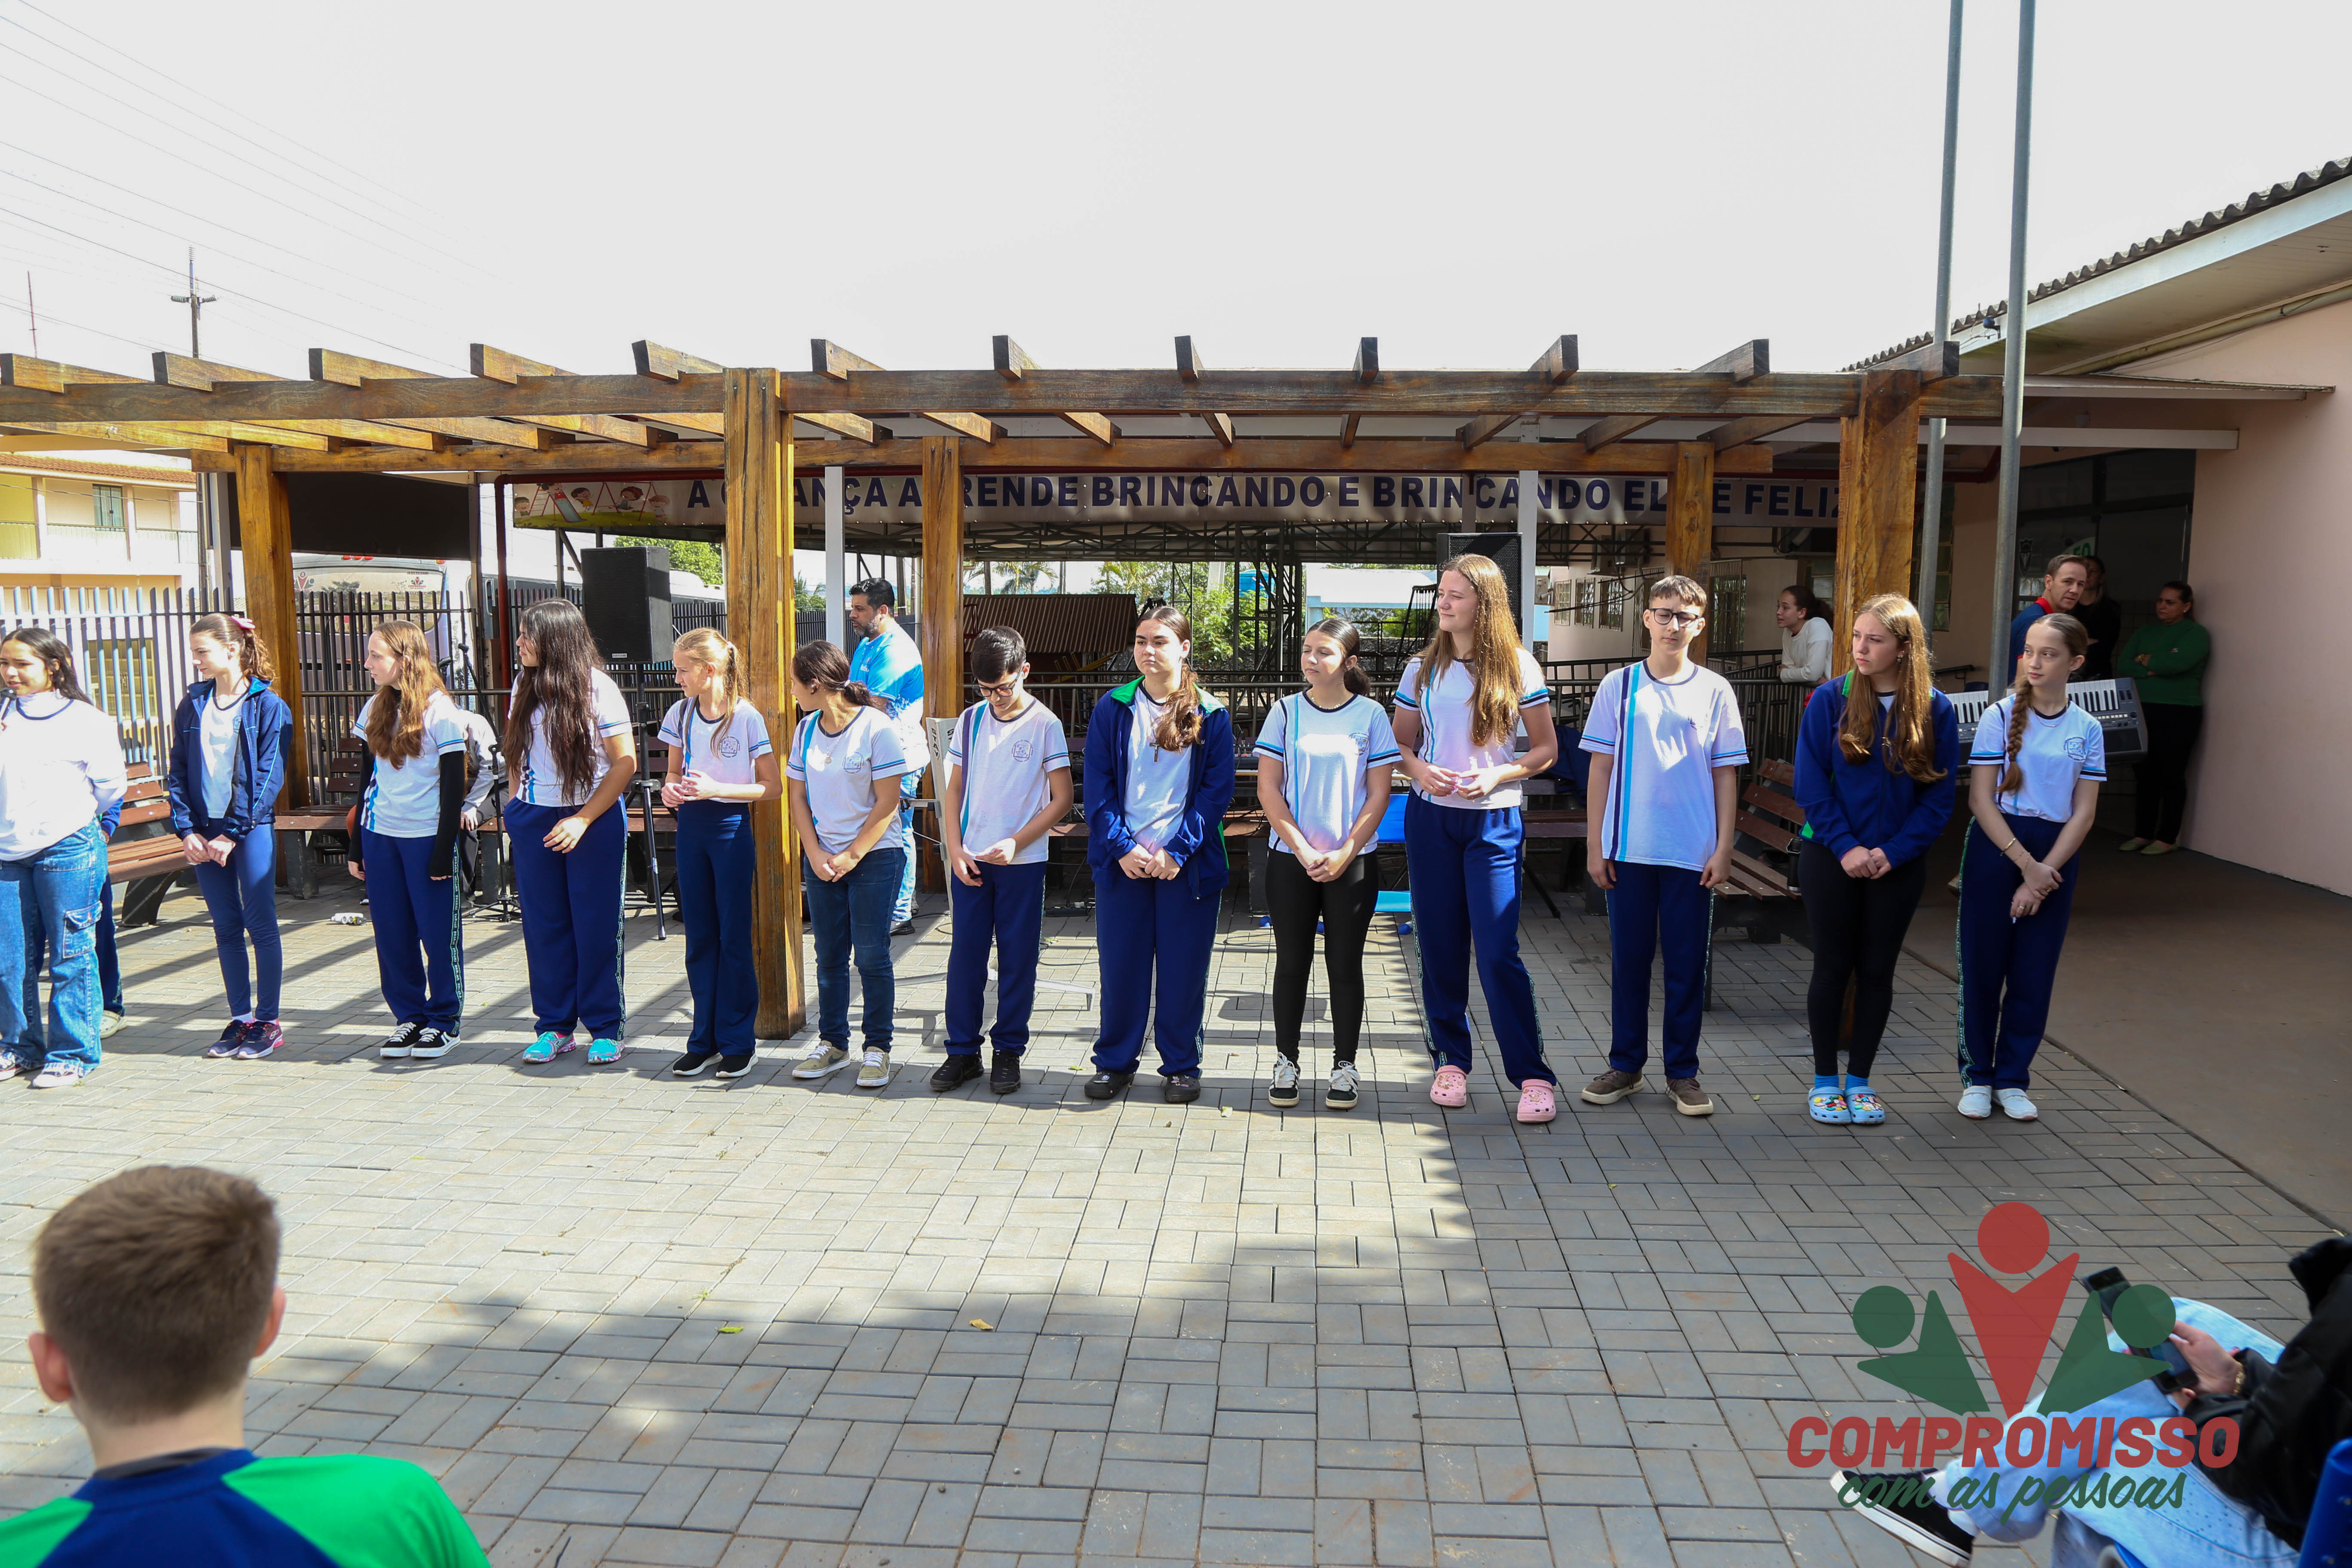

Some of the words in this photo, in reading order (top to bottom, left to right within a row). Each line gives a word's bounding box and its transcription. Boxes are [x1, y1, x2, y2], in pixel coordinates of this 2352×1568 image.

[687, 480, 710, 508] A
[721, 477, 888, 515] ANÇA
[898, 477, 1078, 507] AENDE
[1092, 476, 1325, 507] BRINCANDO
[1338, 477, 1360, 507] E
[1373, 477, 1610, 510] BRINCANDO
[1624, 480, 1667, 511] EL
[931, 727, 940, 761] STAY
